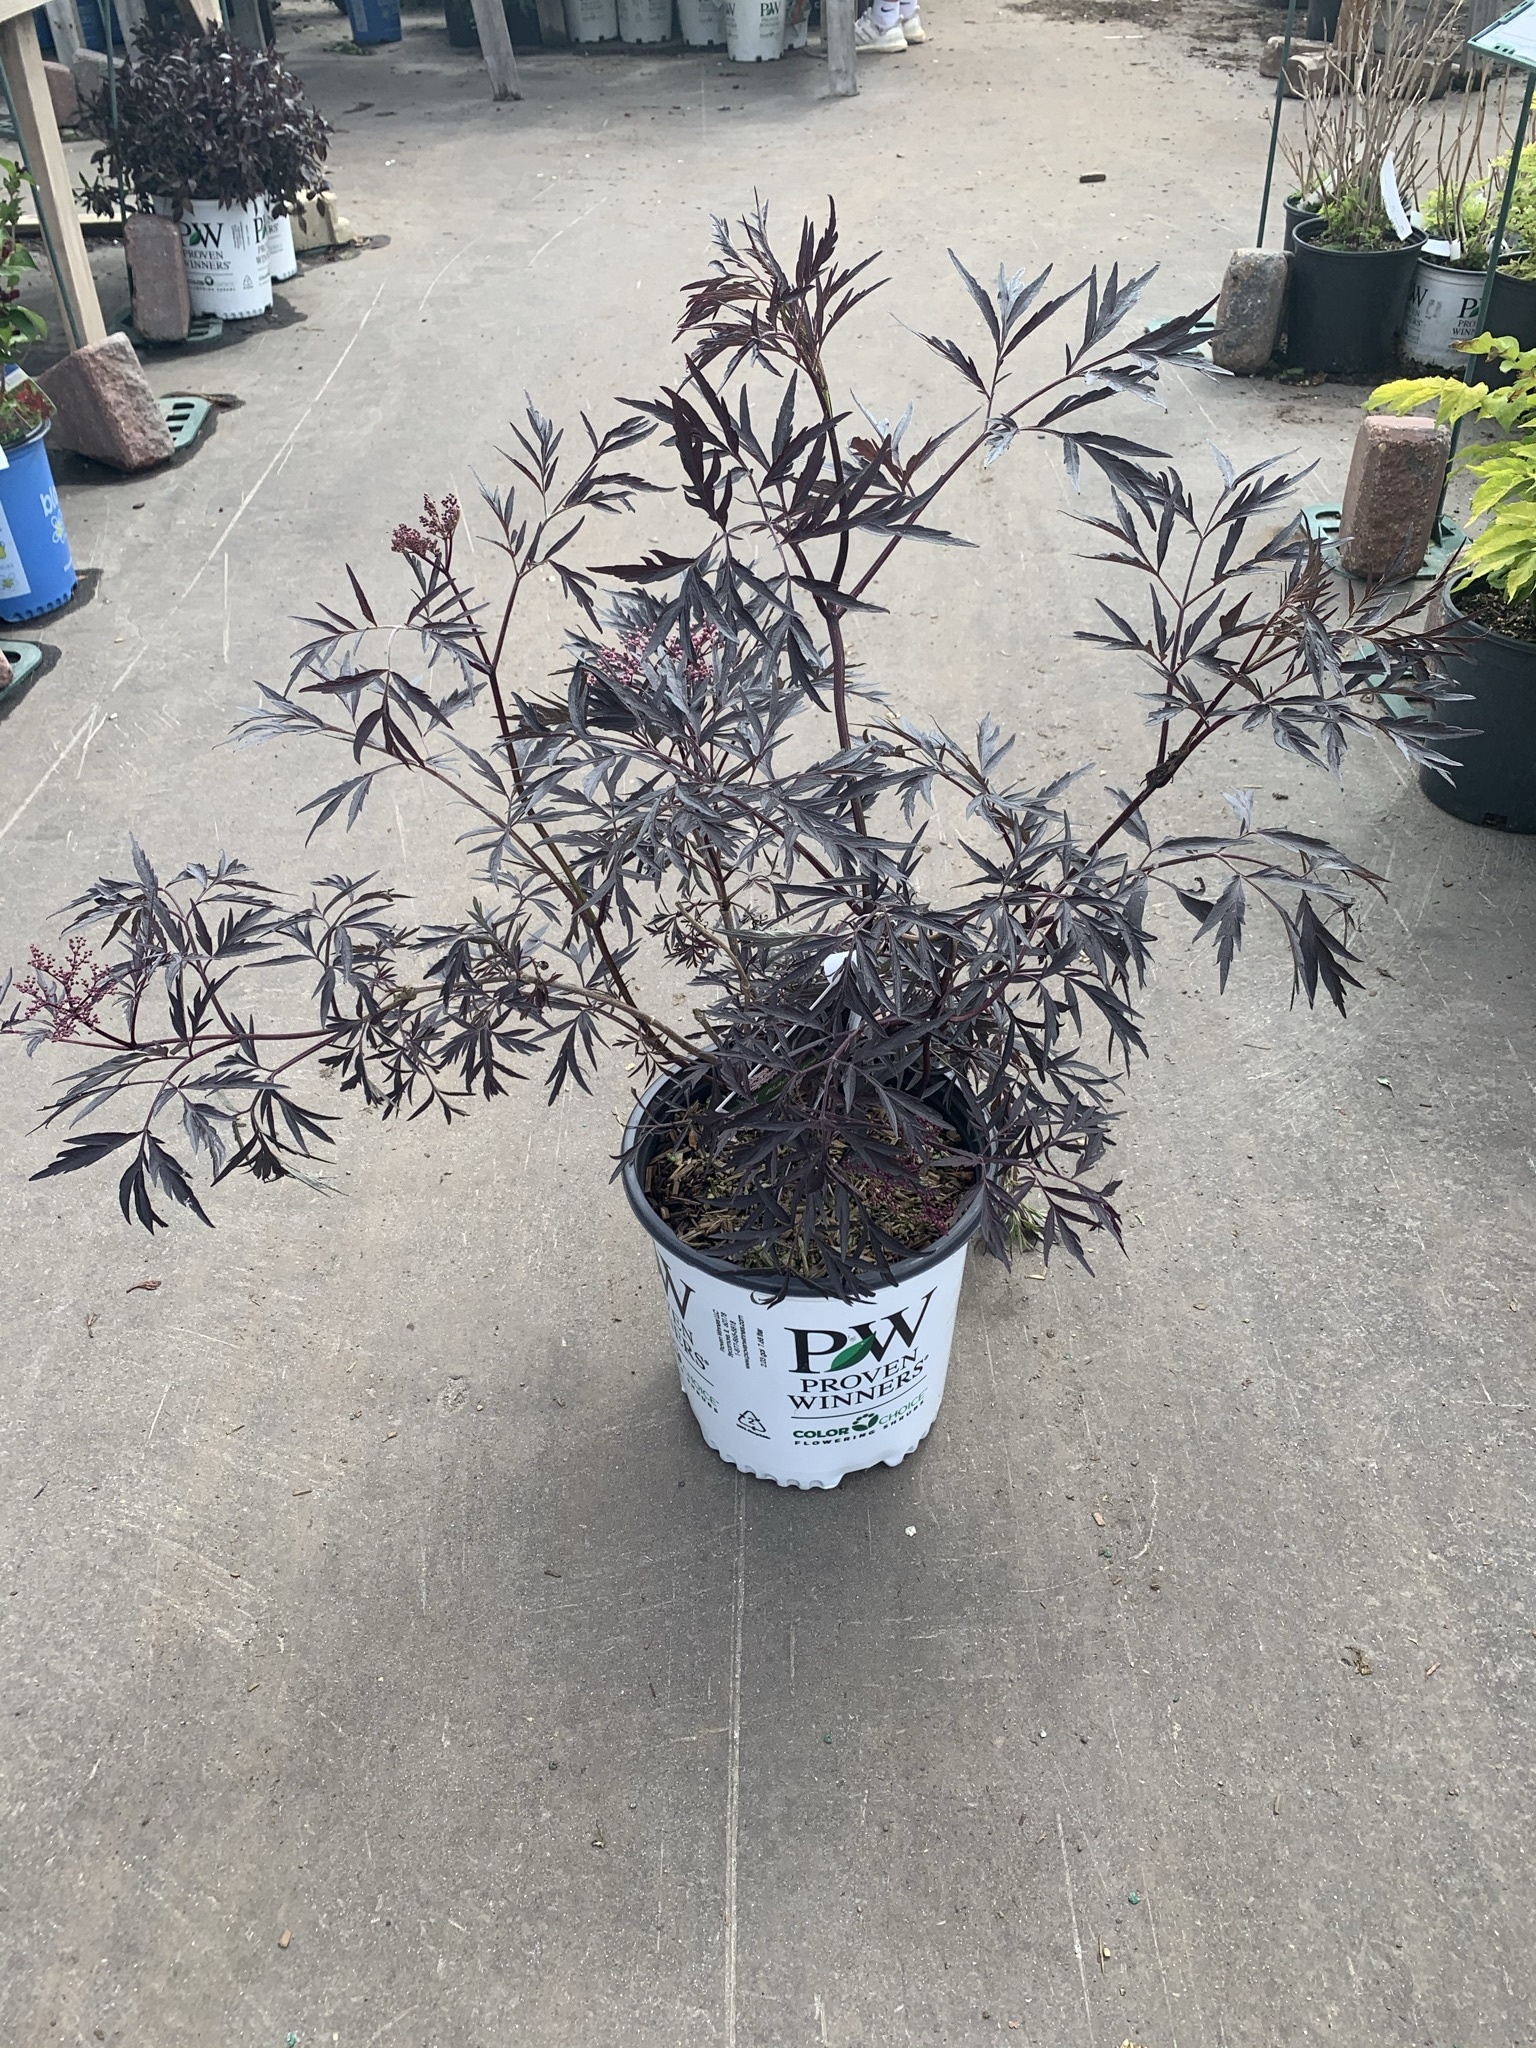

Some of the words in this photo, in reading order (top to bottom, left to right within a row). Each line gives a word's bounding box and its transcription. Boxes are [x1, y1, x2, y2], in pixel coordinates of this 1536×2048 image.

[784, 1286, 938, 1374] PW
[787, 1360, 924, 1410] WINNERS
[800, 1346, 919, 1393] PROVEN
[793, 1427, 850, 1439] COLOR
[879, 1391, 925, 1425] CHOICE
[794, 1430, 876, 1446] FLOWERING
[883, 1400, 924, 1430] SHRUBS
